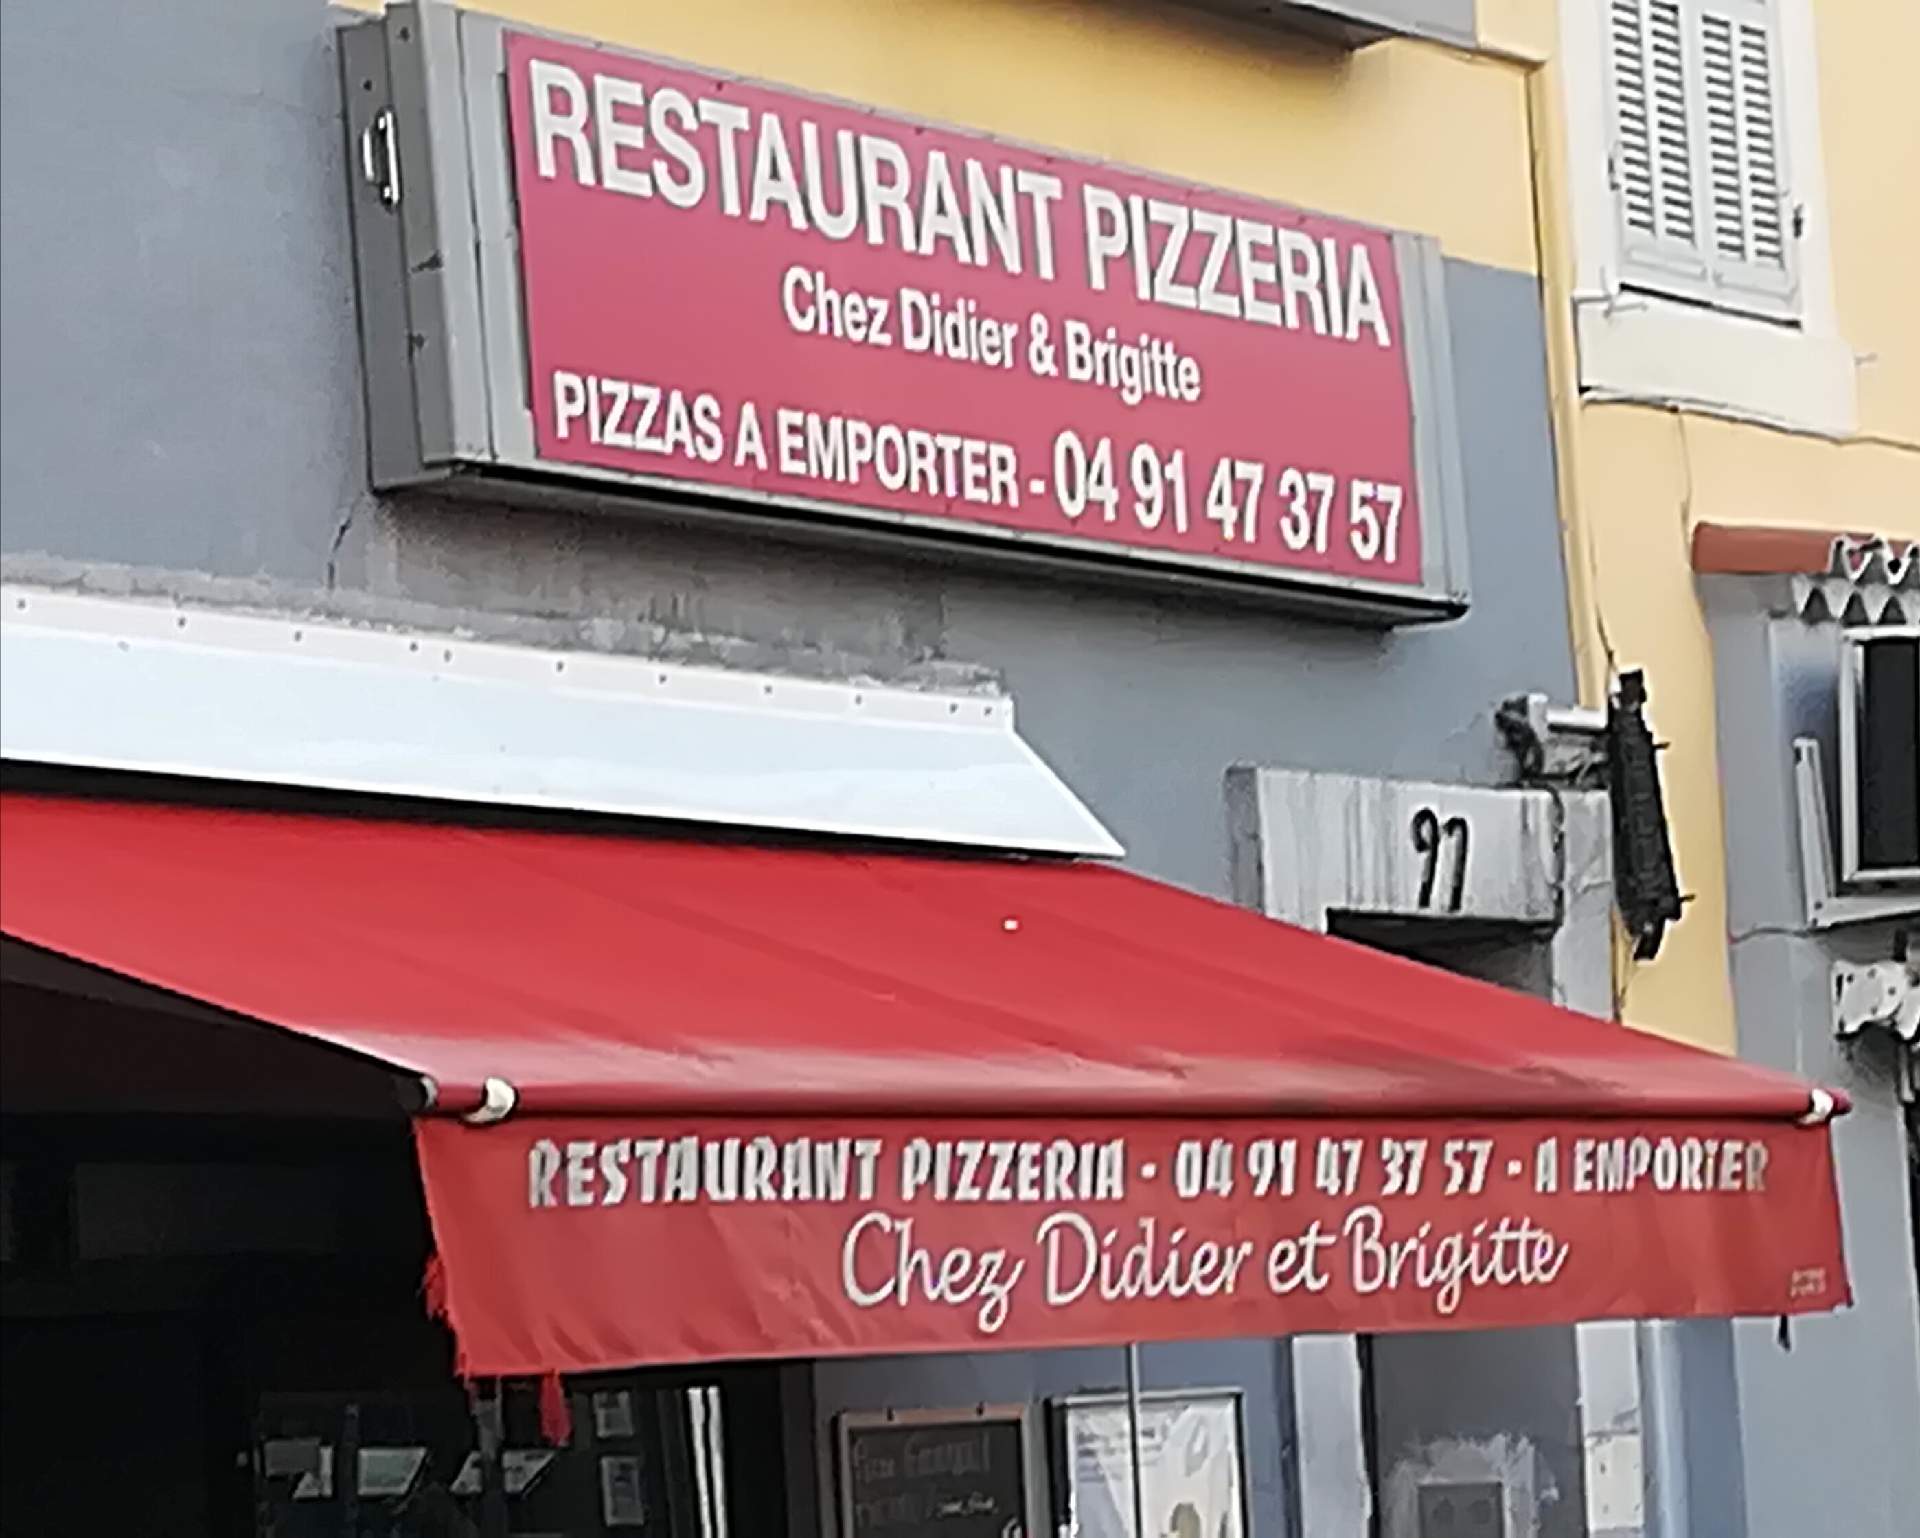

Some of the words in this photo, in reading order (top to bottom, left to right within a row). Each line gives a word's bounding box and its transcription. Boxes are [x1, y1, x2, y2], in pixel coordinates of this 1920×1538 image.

[530, 58, 1063, 281] RESTAURANT
[1082, 183, 1392, 347] PIZZERIA
[782, 264, 893, 347] Chez
[898, 286, 1020, 370] Didier
[1027, 311, 1060, 378] &
[1064, 319, 1201, 406] Brigitte
[553, 370, 724, 463] PIZZAS
[734, 402, 769, 470] A
[776, 408, 1020, 508] EMPORTER
[1053, 429, 1121, 523] 04
[1130, 446, 1189, 535] 91
[1205, 458, 1266, 544] 47
[1277, 470, 1336, 555] 37
[1349, 480, 1404, 565] 57
[1410, 806, 1469, 913] 97
[528, 1135, 883, 1208] RESTAURANT
[901, 1137, 1125, 1203] PIZZERIA
[1175, 1138, 1234, 1199] 04
[1247, 1138, 1298, 1197] 91
[1314, 1136, 1364, 1197] 47
[1380, 1137, 1426, 1197] 37
[1443, 1139, 1494, 1196] 57
[1534, 1136, 1558, 1194] A
[1573, 1136, 1767, 1193] EMPORTER
[842, 1211, 1028, 1334] Chez
[1035, 1211, 1254, 1306] Didier
[1267, 1218, 1336, 1294] et
[1342, 1204, 1570, 1315] Brigitte
